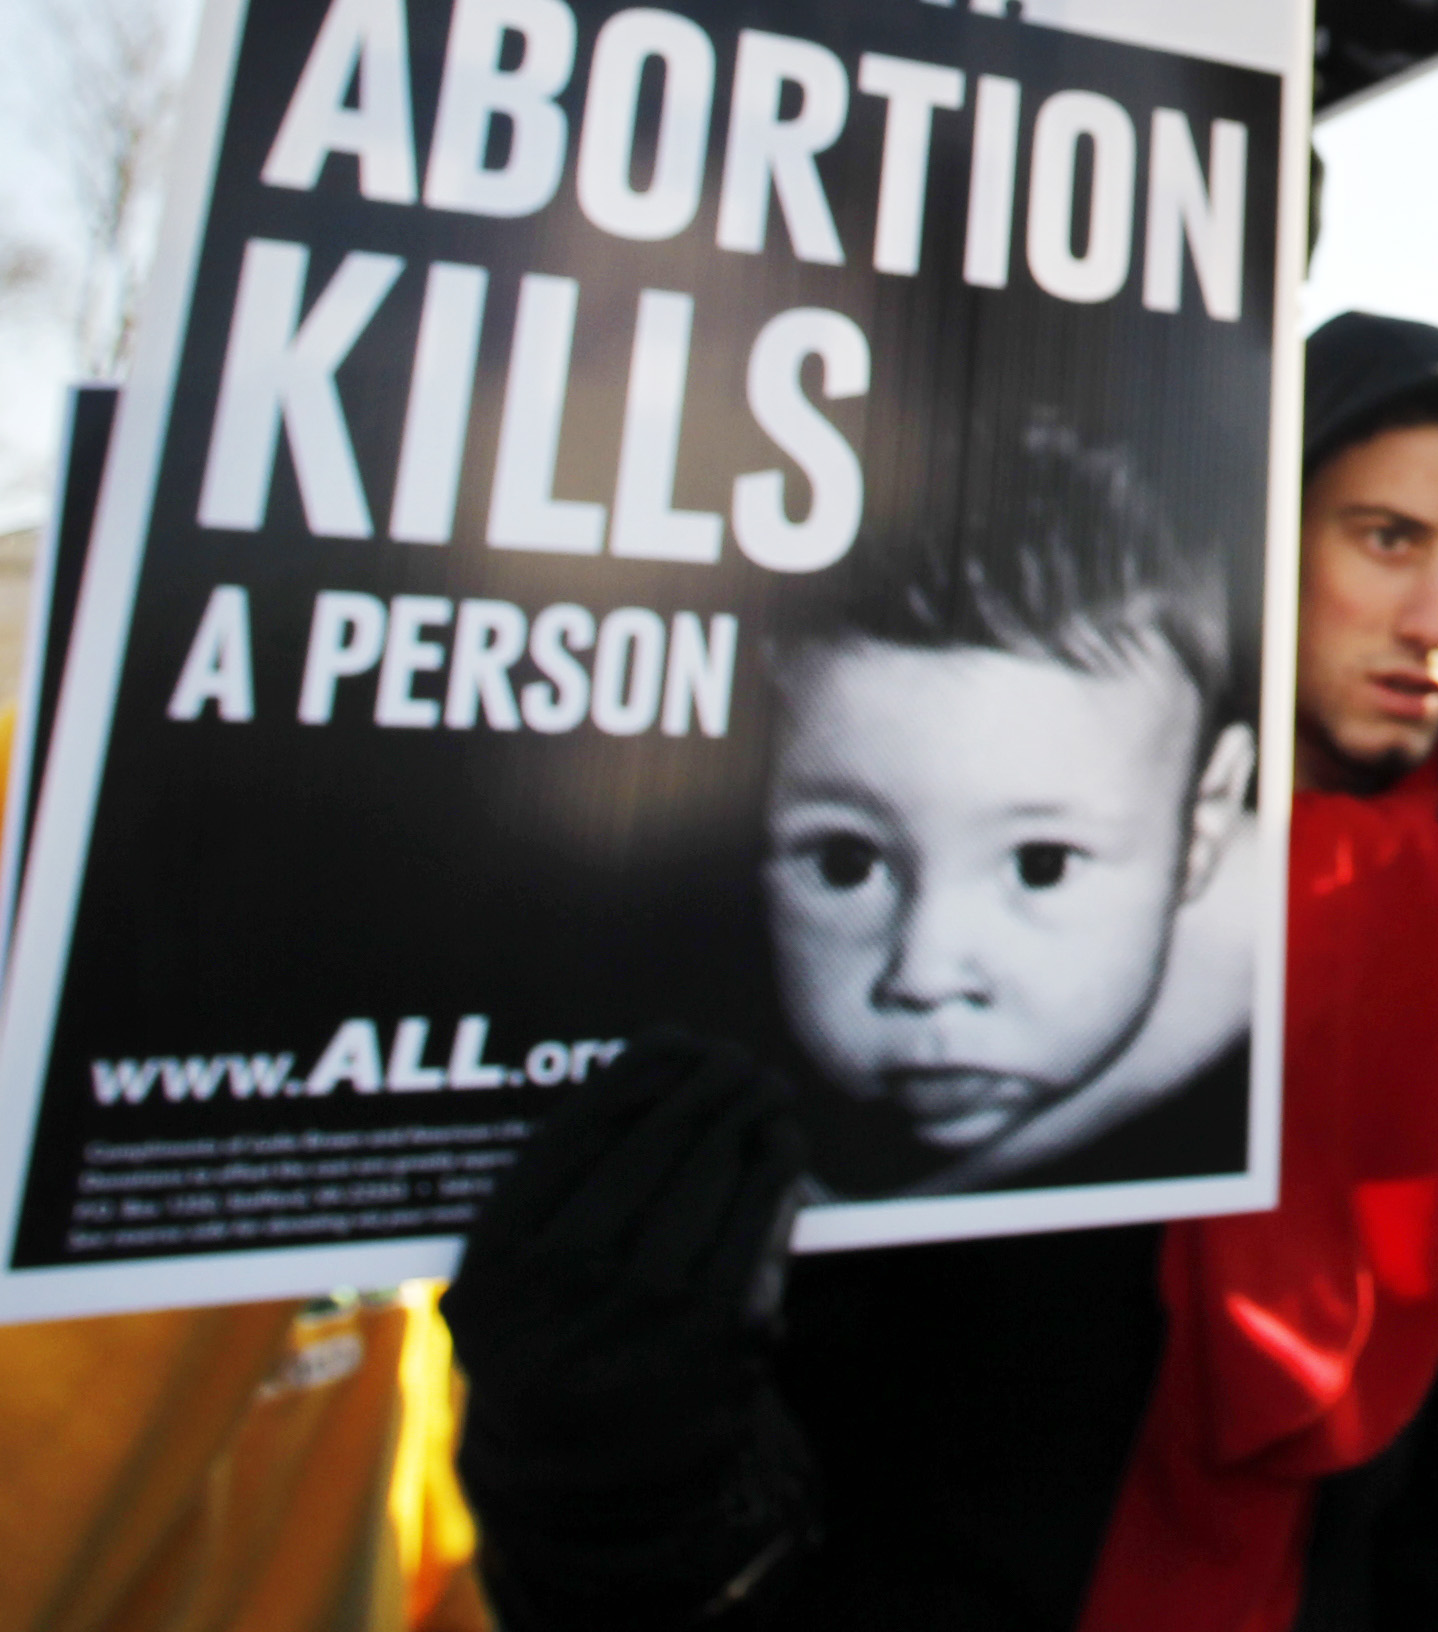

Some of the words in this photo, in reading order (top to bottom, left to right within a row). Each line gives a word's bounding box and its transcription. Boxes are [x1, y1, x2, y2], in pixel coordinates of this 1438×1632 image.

[196, 238, 874, 574] KILLS
[168, 586, 256, 723] A
[297, 589, 740, 739] PERSON
[90, 1013, 630, 1107] www.ALL.or
